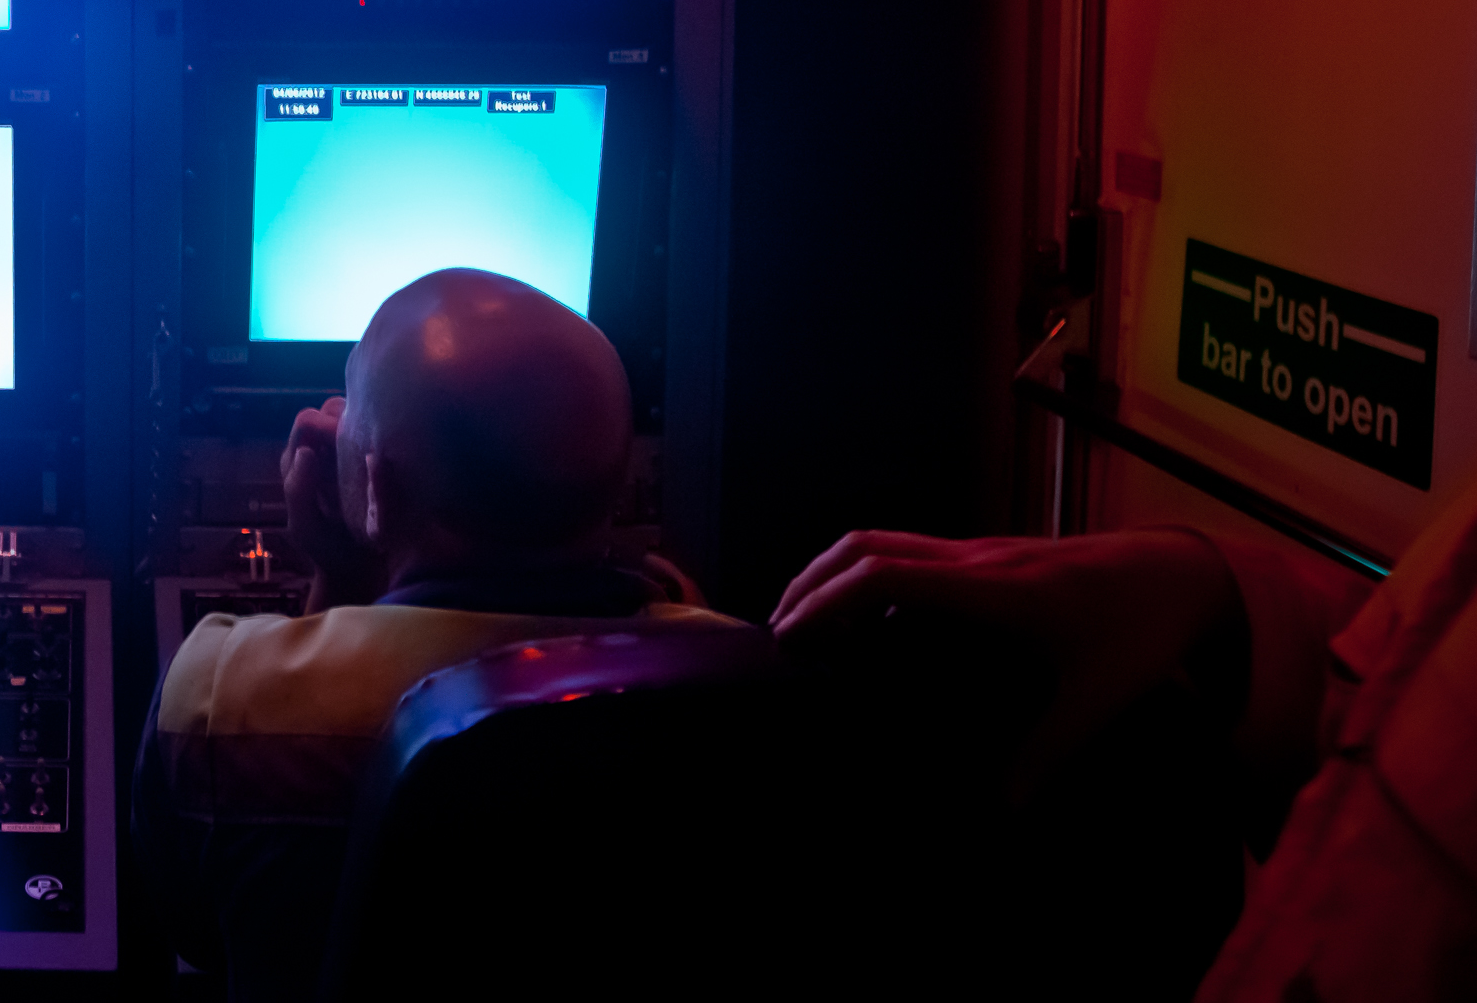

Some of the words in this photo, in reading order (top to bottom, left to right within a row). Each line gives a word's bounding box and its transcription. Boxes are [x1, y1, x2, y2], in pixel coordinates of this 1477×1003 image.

[345, 89, 354, 100] E
[415, 89, 424, 100] N
[1253, 274, 1340, 352] Push
[1201, 321, 1253, 383] bar
[1260, 348, 1293, 402] to
[1304, 376, 1399, 448] open
